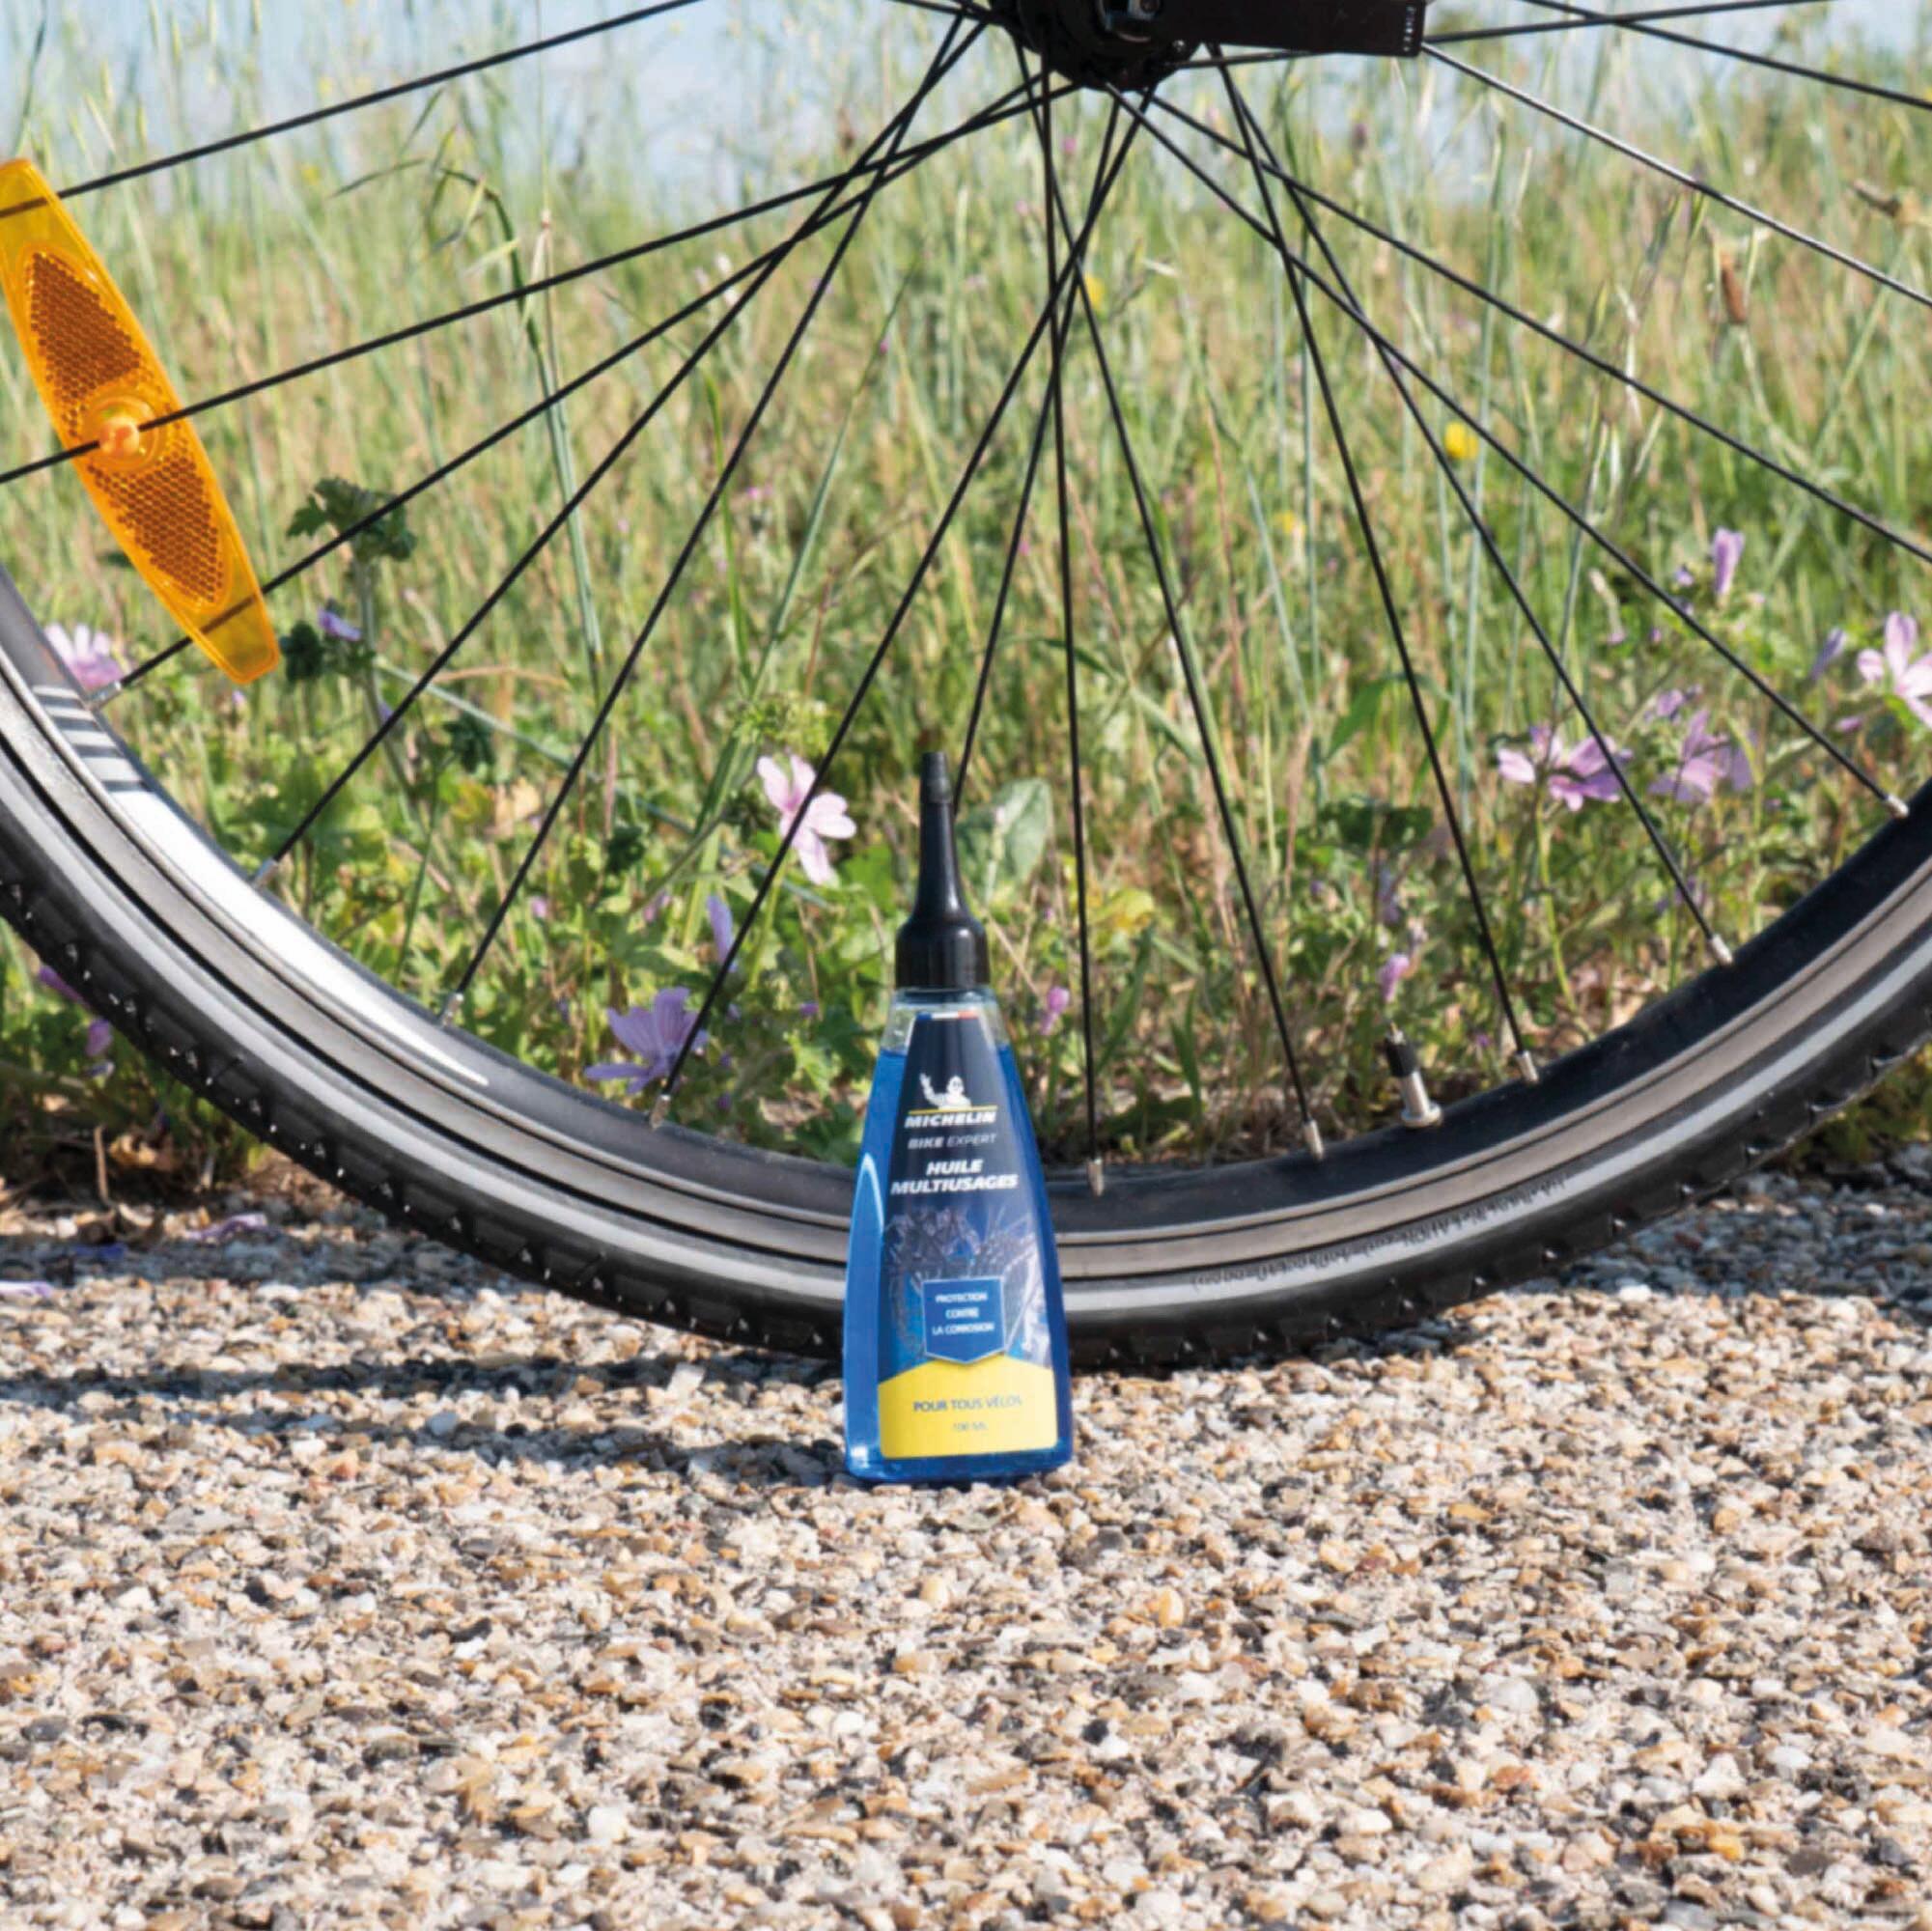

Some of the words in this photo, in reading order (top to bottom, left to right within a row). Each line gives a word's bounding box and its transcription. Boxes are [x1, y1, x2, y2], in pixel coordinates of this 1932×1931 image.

[905, 1111, 996, 1128] MICHELIN
[908, 1136, 944, 1150] BIKE
[947, 1133, 995, 1147] EXPERT
[926, 1159, 983, 1175] HUILE
[891, 1174, 1019, 1194] MULTIUSAGES
[935, 1292, 988, 1303] PROTECTION
[945, 1307, 979, 1319] CONTRE
[932, 1326, 943, 1335] LA
[945, 1322, 995, 1334] CORROSION
[912, 1400, 948, 1413] POUR
[951, 1398, 982, 1410] TOUS
